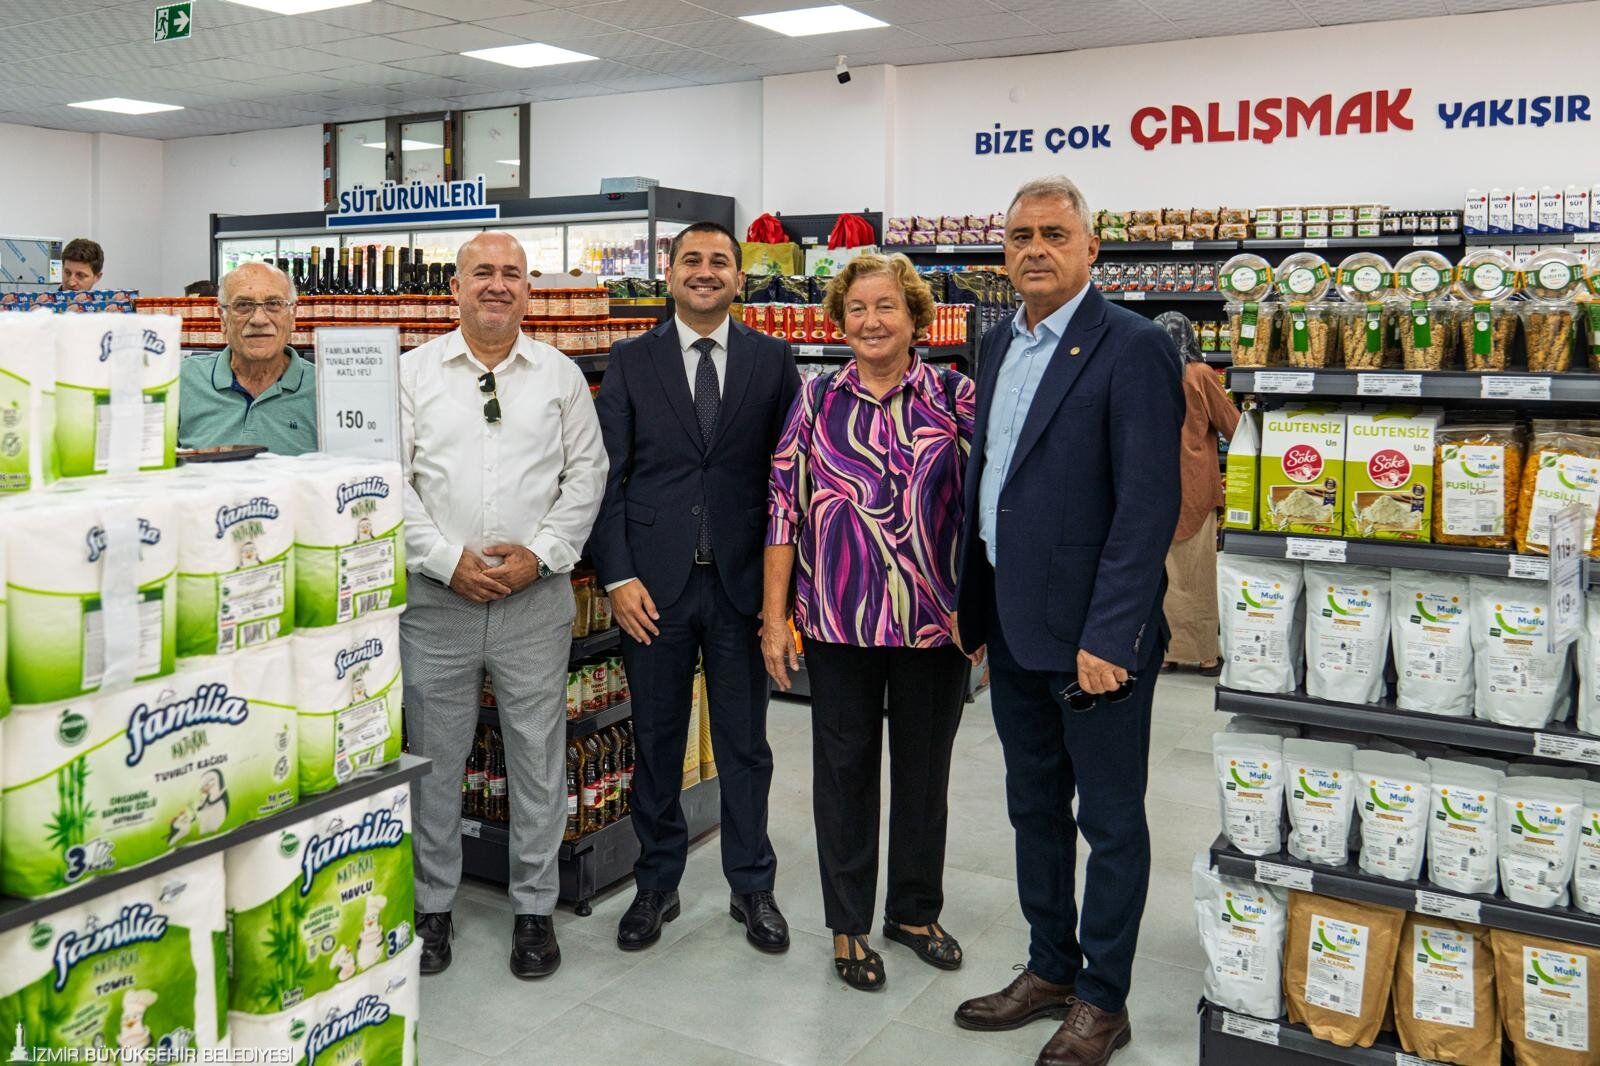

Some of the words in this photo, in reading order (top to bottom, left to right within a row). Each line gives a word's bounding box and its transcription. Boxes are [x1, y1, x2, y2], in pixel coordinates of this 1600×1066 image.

[975, 123, 1033, 155] BİZE
[1045, 124, 1111, 154] ÇOK
[1130, 88, 1414, 150] ÇALIŞMAK
[1437, 94, 1592, 130] YAKIŞIR
[340, 185, 377, 214] SÜT
[381, 176, 483, 210] ÜRÜNLERİ
[325, 346, 350, 354] FAMILIA
[352, 346, 382, 354] NATURAL
[326, 358, 354, 366] TUVALET
[336, 410, 364, 429] 150
[368, 421, 376, 430] 00
[1268, 421, 1342, 434] GLUTENSİZ
[1352, 424, 1430, 439] GLUTENSİZ
[1326, 439, 1337, 447] Un
[1414, 444, 1426, 452] Un
[1287, 450, 1318, 468] Söke
[1372, 454, 1406, 473] Söke
[337, 476, 390, 514] familia
[216, 496, 280, 539] familia
[1260, 592, 1285, 600] Mutlu
[1347, 598, 1372, 608] Mutlu
[1436, 605, 1462, 616] Mutlu
[1517, 616, 1545, 626] Mutlu
[126, 682, 249, 767] familia
[154, 762, 194, 783] TUVALET
[1249, 772, 1272, 780] Mutlu
[1318, 780, 1342, 790] Mutlu
[1390, 792, 1414, 804] Mutlu
[1462, 802, 1488, 814] Mutlu
[1538, 815, 1566, 826] Mutlu
[301, 808, 404, 898] familia
[68, 846, 86, 879] 3
[341, 880, 374, 902] HAVLU
[1244, 905, 1268, 915] Mutlu
[54, 902, 168, 992] familia
[388, 930, 398, 956] 3
[1336, 934, 1361, 947] Mutlu
[1442, 942, 1468, 954] Mutlu
[1554, 966, 1582, 978] Mutlu
[96, 975, 134, 996] TOWEL
[304, 994, 390, 1066] familia
